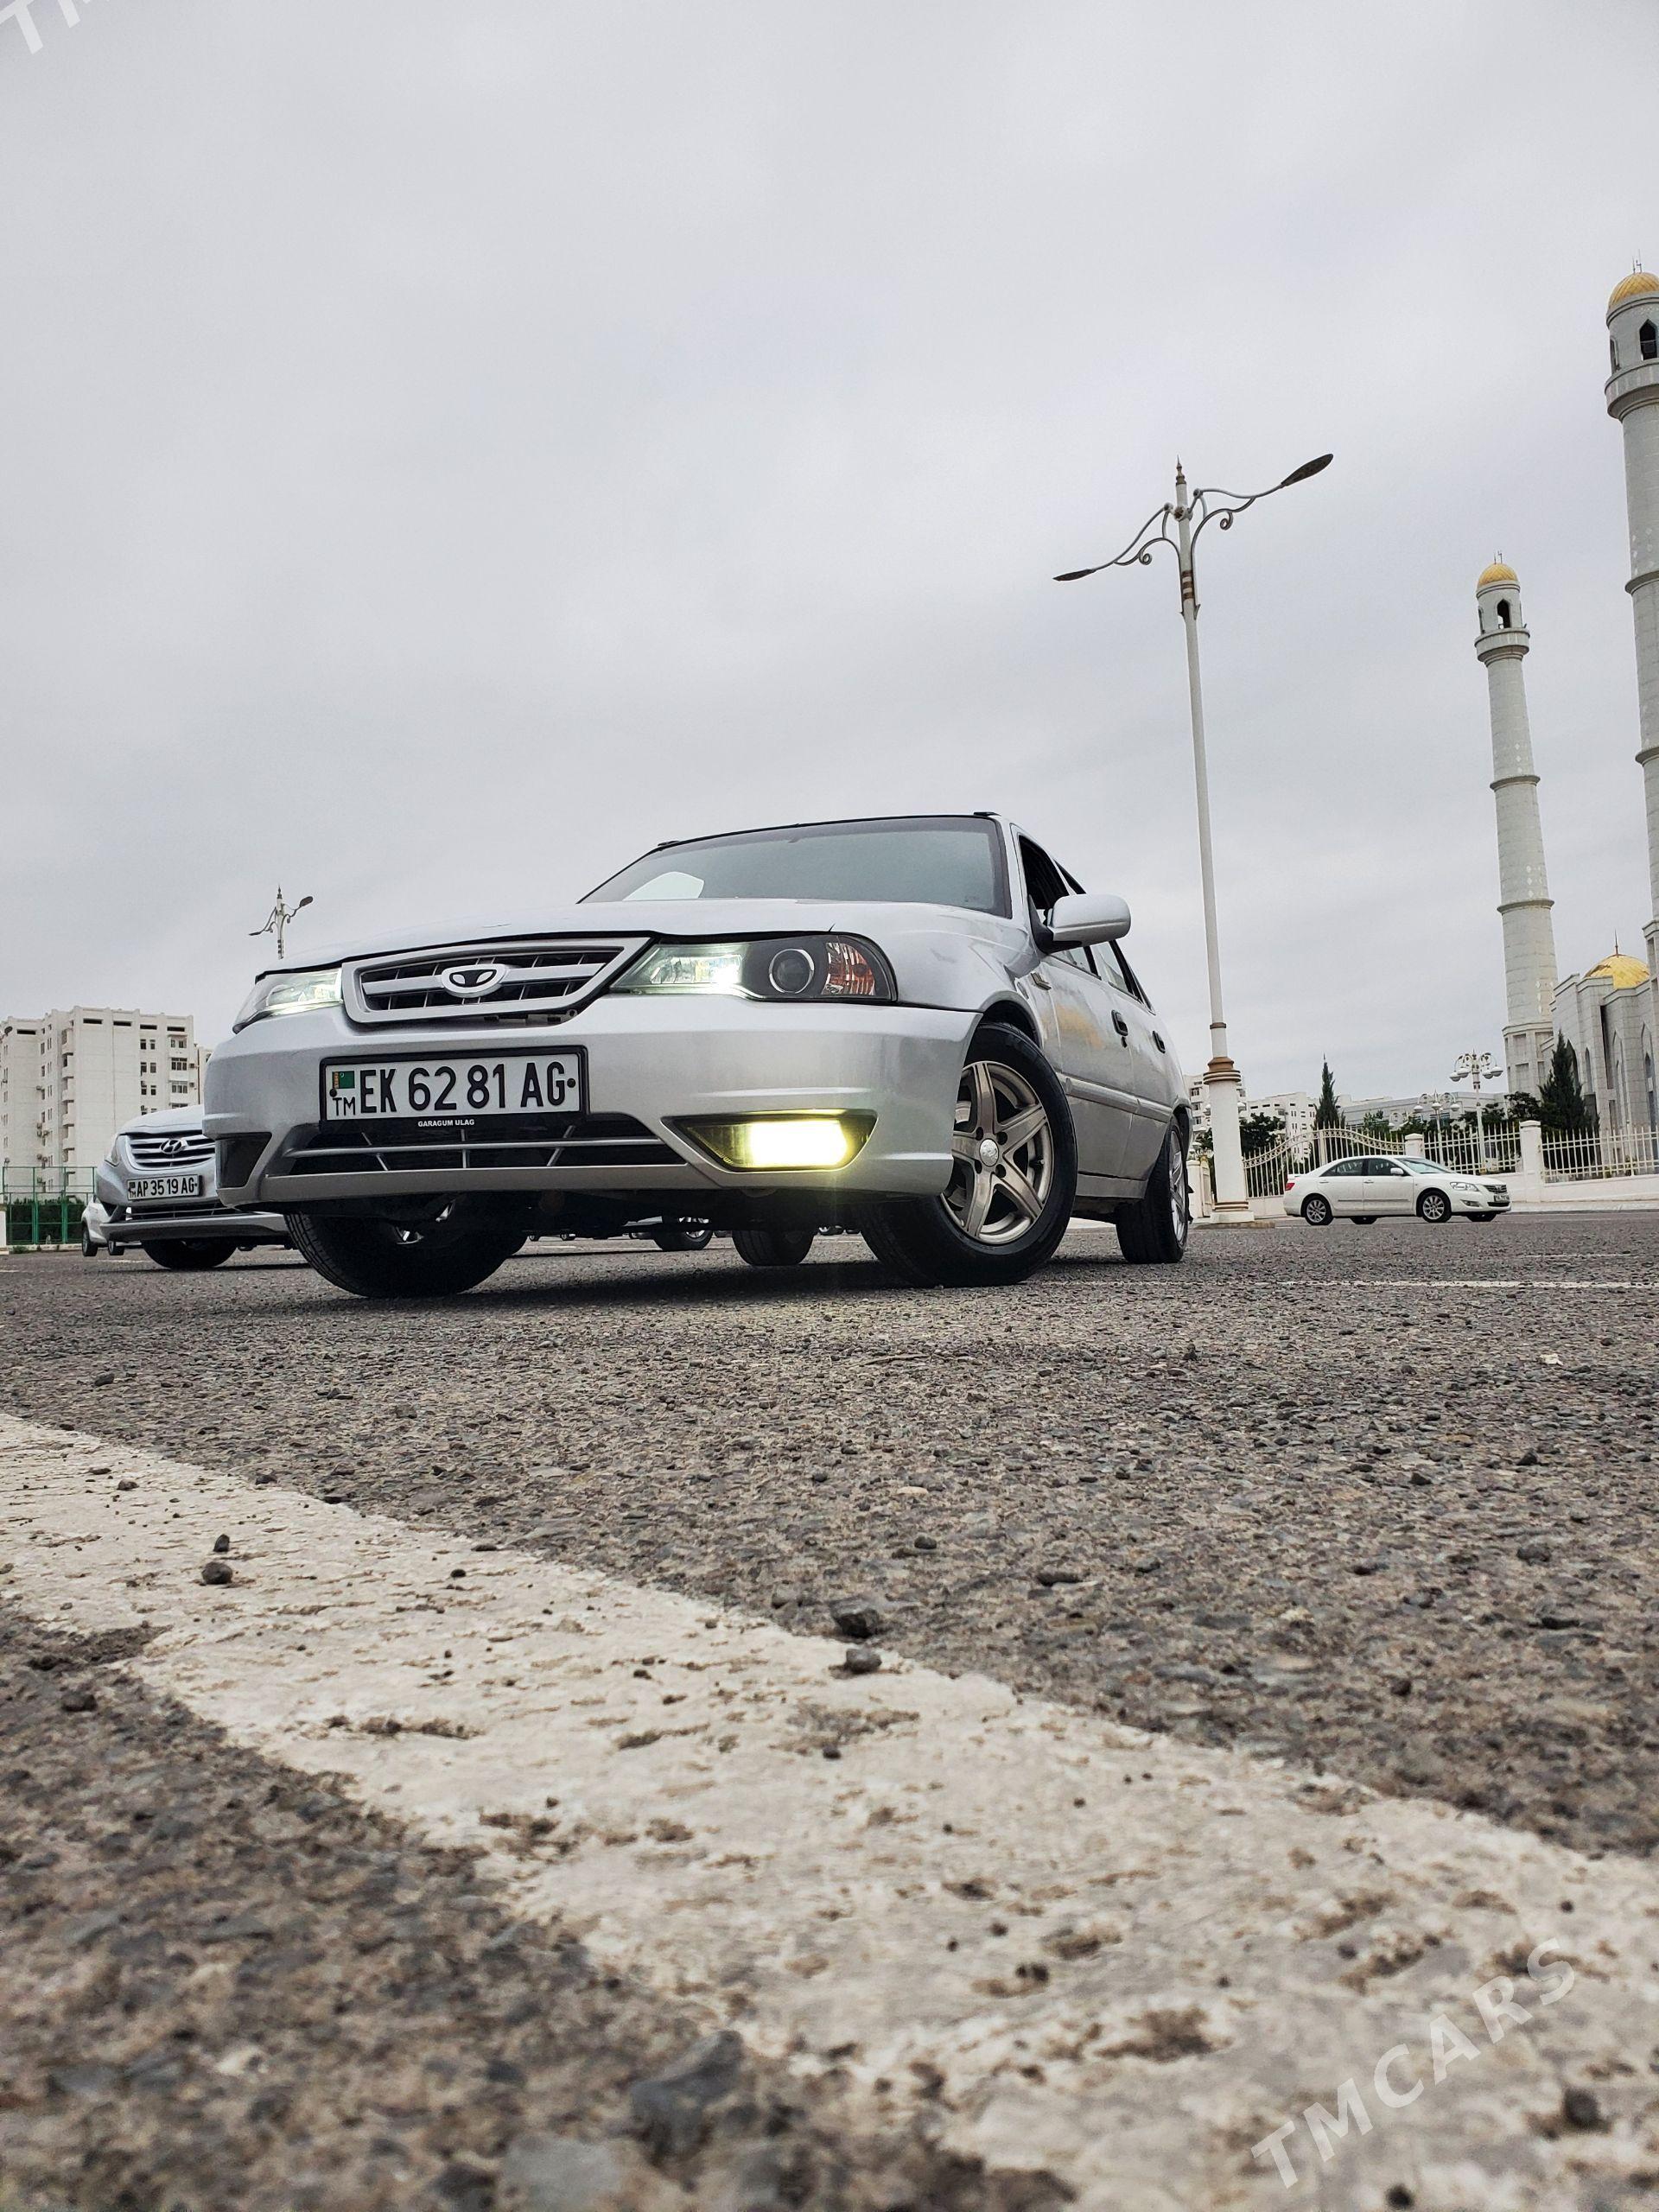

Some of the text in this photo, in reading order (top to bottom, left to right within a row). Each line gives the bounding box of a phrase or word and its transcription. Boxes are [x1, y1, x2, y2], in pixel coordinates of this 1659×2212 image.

[359, 1069, 397, 1114] EK
[520, 1061, 566, 1108] AG
[332, 1096, 356, 1116] TM
[137, 1180, 149, 1198] AP
[181, 1177, 195, 1194] AG
